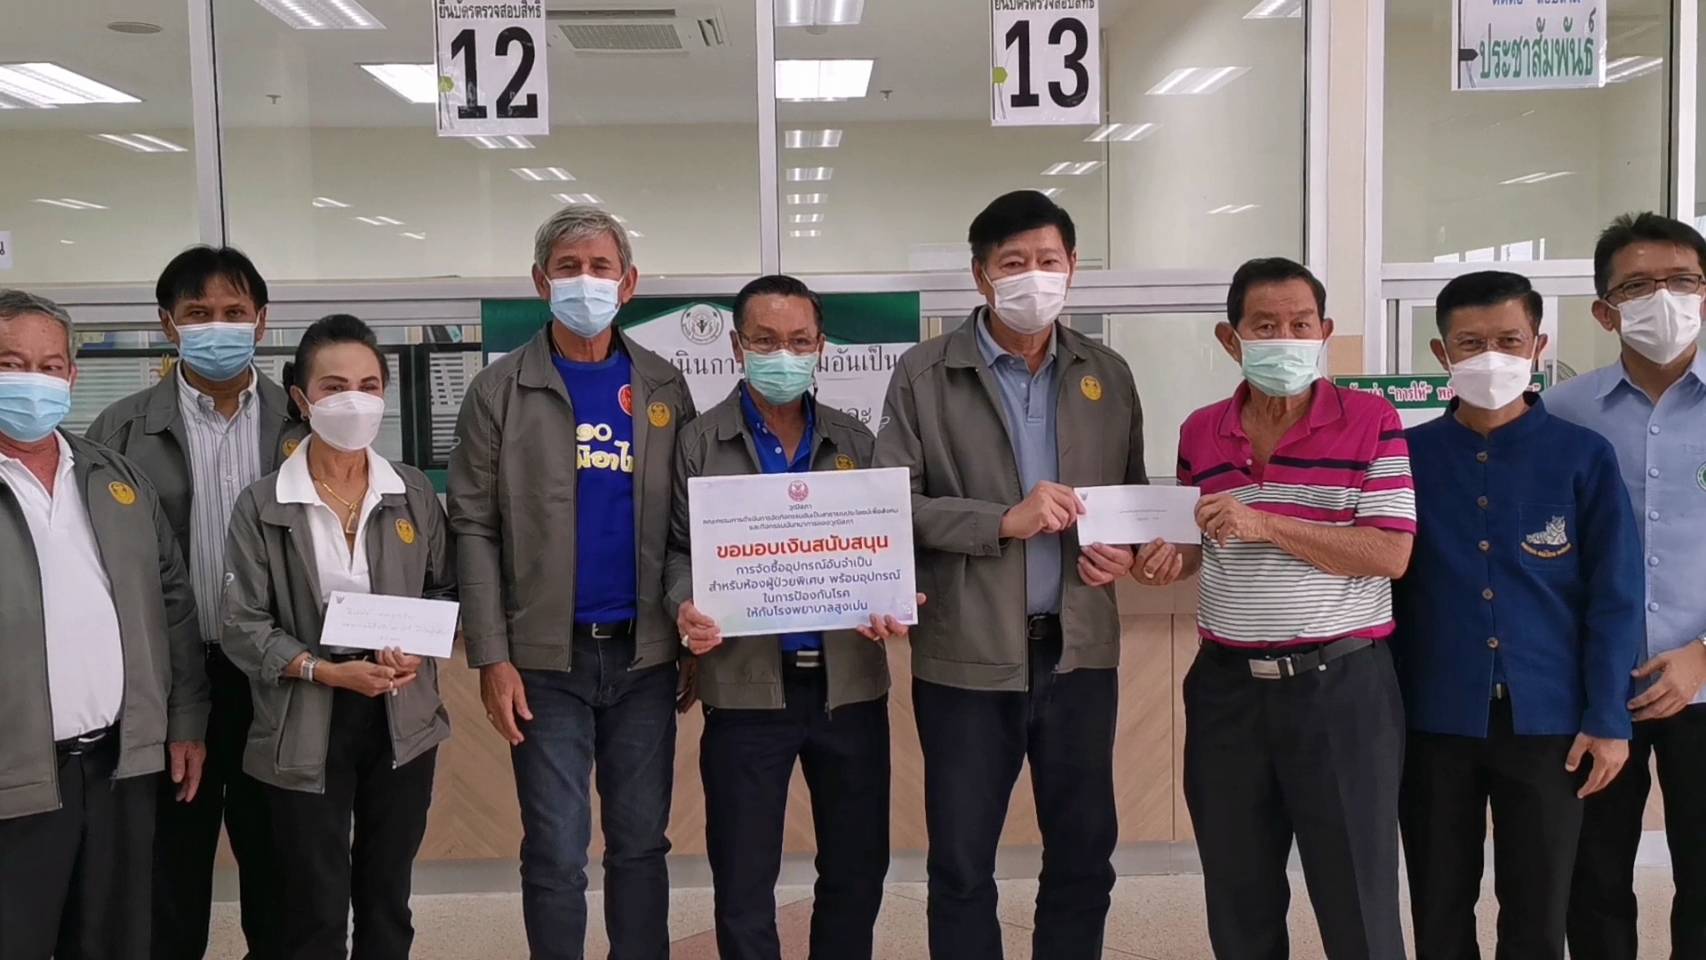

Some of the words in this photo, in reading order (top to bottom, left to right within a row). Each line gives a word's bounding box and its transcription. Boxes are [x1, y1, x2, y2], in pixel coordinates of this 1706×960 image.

[1479, 7, 1597, 79] ประชาสัมพันธ์
[450, 26, 539, 119] 12
[1005, 17, 1090, 108] 13
[716, 534, 889, 559] ขอมอบเงินสนับสนุน
[735, 556, 873, 577] การจัดซื้ออุปกรณ์อันจำเป็น
[708, 575, 825, 593] สำหรับห้องผู้ป่วยพิเศษ
[829, 569, 902, 587] พร้อมอุปกรณ์
[763, 587, 850, 604] ในการป้องกันโรค
